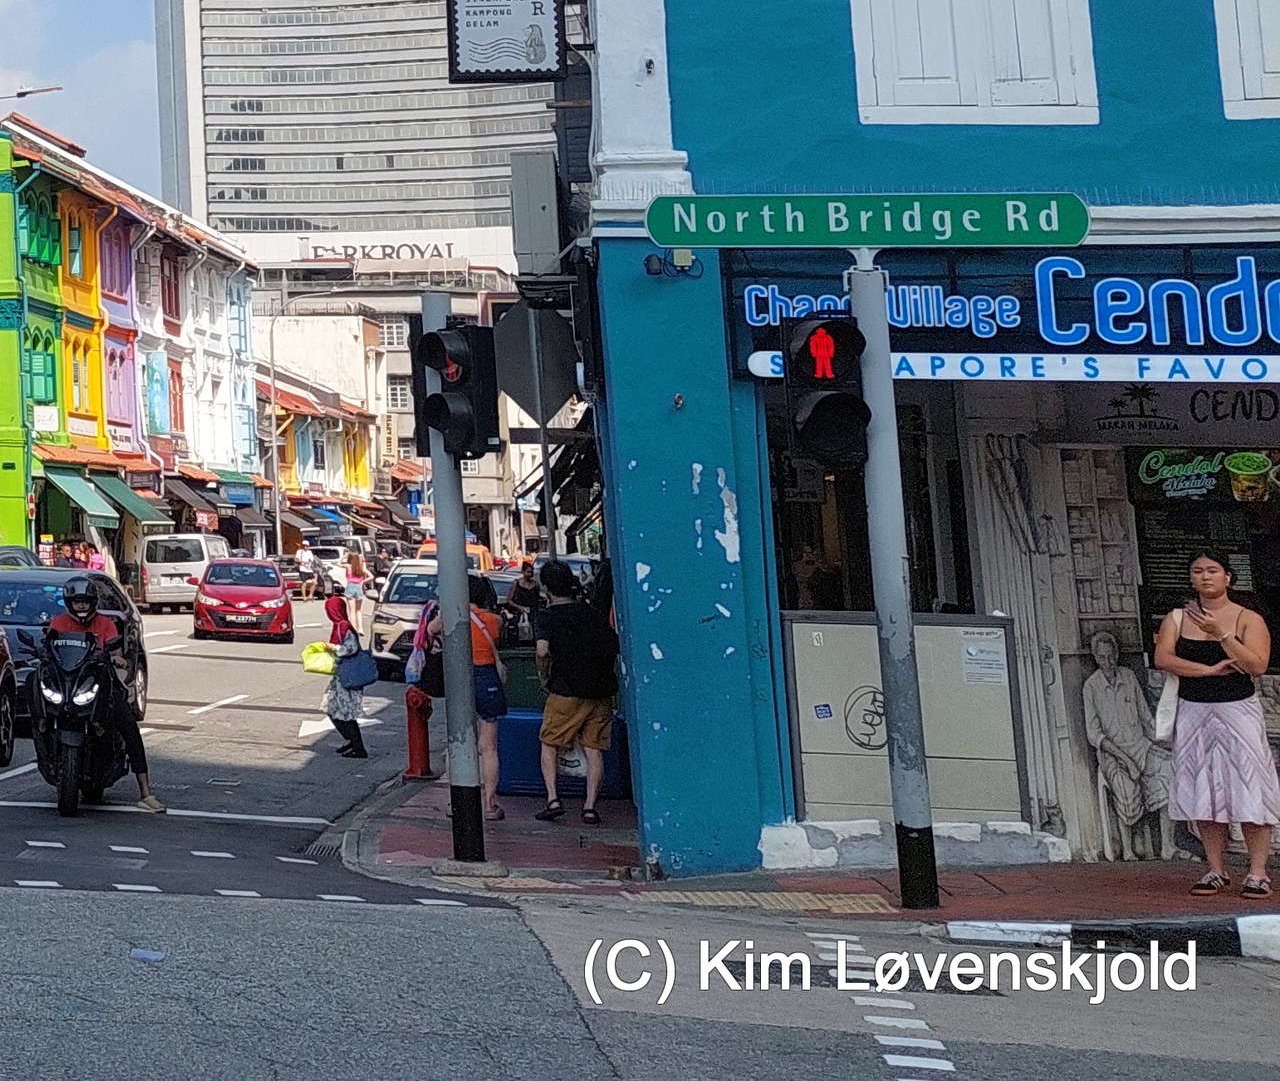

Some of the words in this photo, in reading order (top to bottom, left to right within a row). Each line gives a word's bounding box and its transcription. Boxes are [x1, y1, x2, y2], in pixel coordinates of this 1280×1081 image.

[465, 20, 499, 28] GELAM
[673, 202, 805, 234] North
[828, 201, 981, 240] Bridge
[1005, 200, 1060, 233] Rd
[888, 285, 1020, 337] Village
